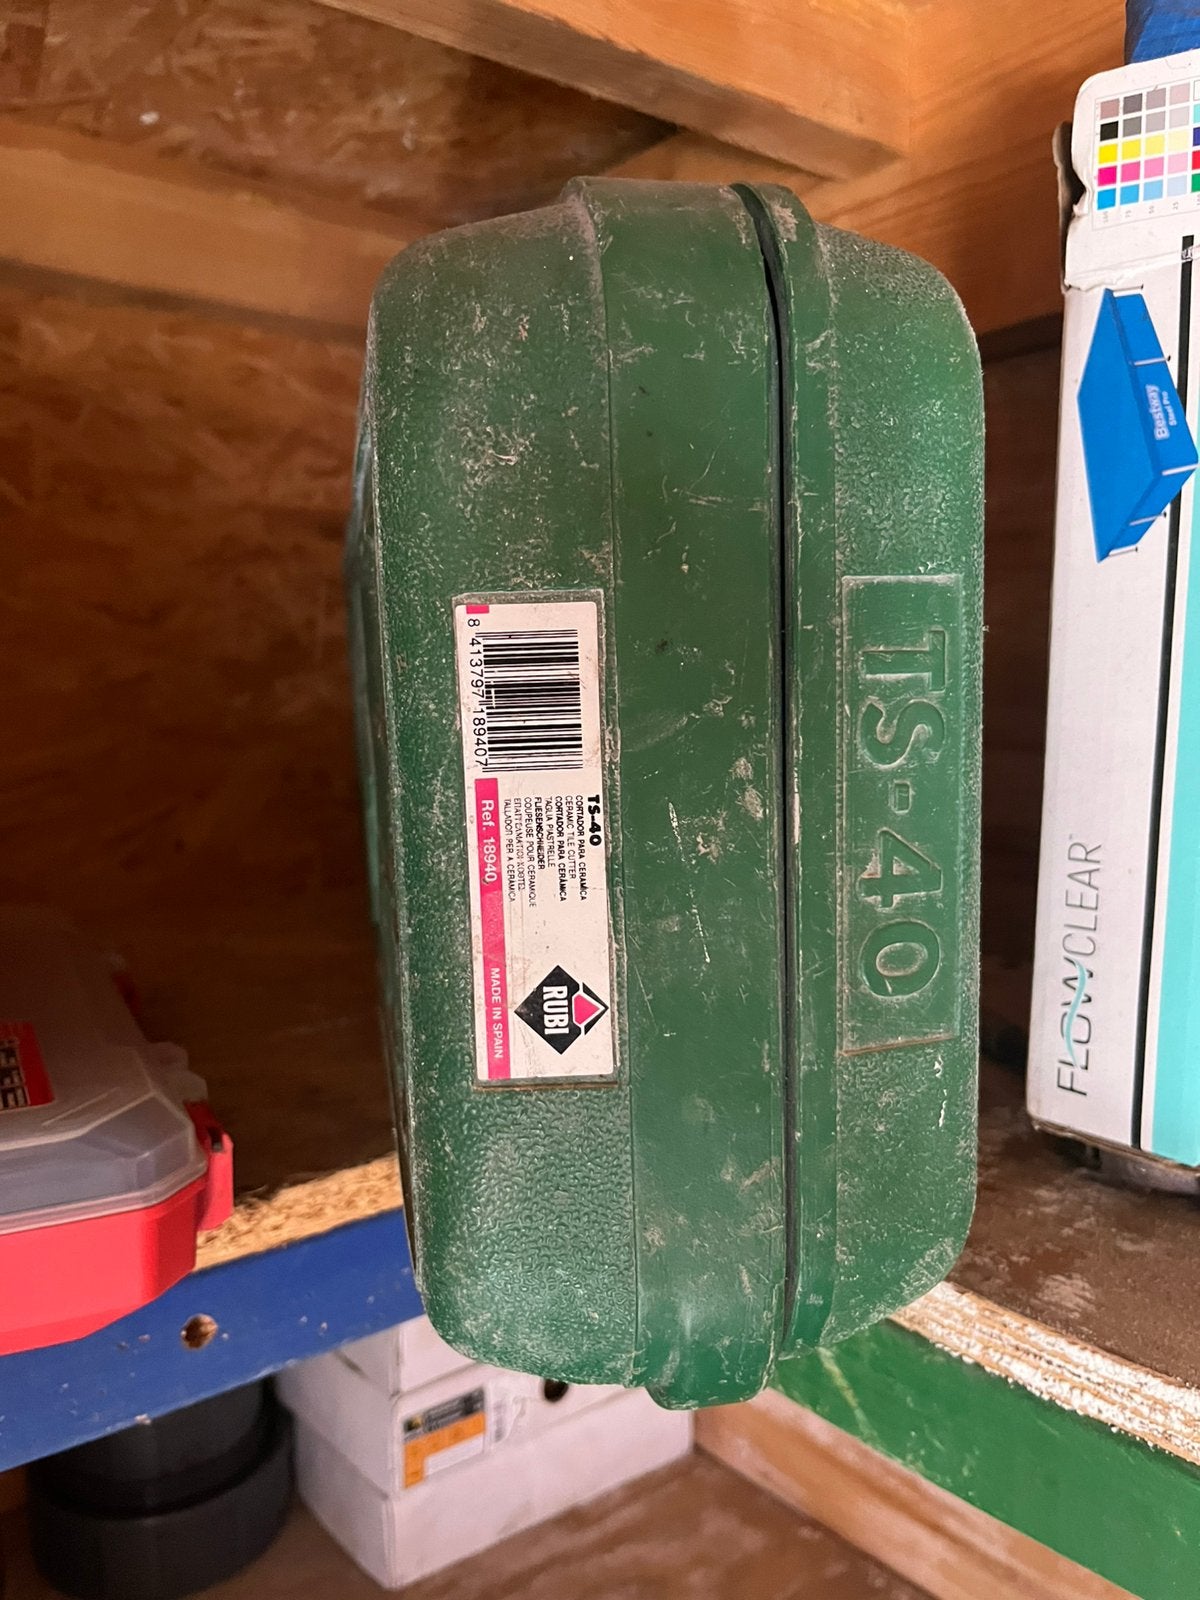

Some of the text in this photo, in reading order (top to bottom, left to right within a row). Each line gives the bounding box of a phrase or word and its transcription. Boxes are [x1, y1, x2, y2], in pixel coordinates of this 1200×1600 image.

[467, 618, 488, 767] 8 413797 189407
[504, 799, 513, 836] TALLADOR
[524, 797, 534, 838] COUPEUSE
[534, 796, 545, 870] FLIESENSCHNEIDER
[545, 796, 556, 868] TAGLIA PIASTRELLE
[555, 796, 564, 838] CORTADOR
[565, 795, 576, 879] CERAMIC TILE CUTTER
[576, 795, 585, 836] CORTADOR
[587, 794, 602, 847] TS-40
[481, 799, 498, 882] Ref. 18940
[506, 838, 514, 854] PER
[526, 840, 535, 863] POUR
[557, 840, 565, 860] PARA
[578, 839, 586, 859] PARA
[490, 967, 503, 1059] MADE IN SPAIN
[542, 985, 569, 1035] RUBI
